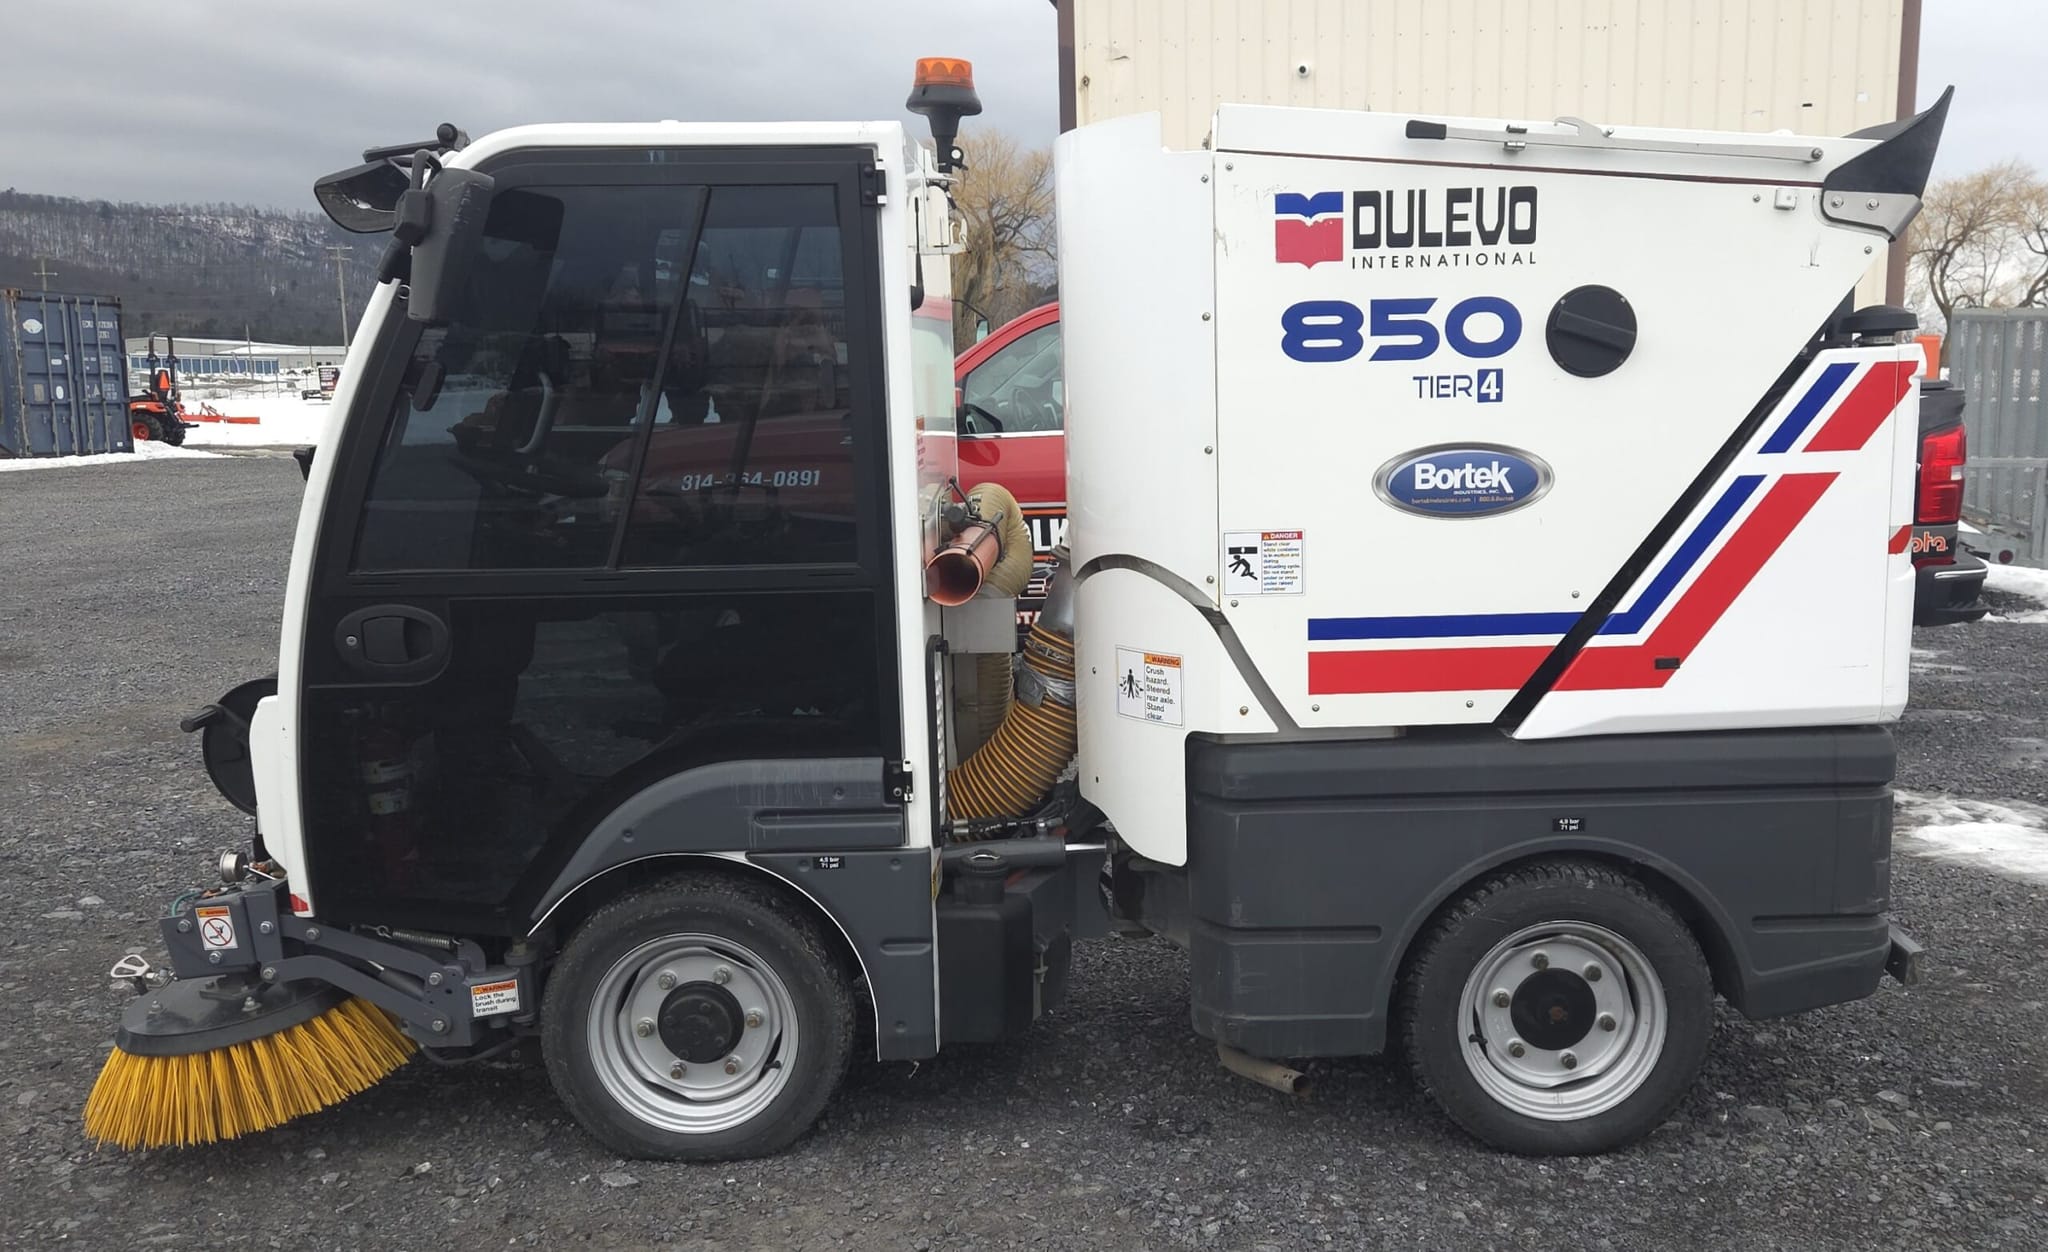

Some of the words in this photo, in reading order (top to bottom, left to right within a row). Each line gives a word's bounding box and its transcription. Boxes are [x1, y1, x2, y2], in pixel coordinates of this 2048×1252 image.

[1352, 185, 1538, 249] DULEVO
[1352, 251, 1537, 269] INTERNATIONAL
[1281, 296, 1523, 363] 850
[1412, 375, 1473, 399] TIER
[1479, 371, 1501, 400] 4
[1414, 461, 1514, 494] Bortek
[1151, 656, 1179, 666] WARNING
[1146, 666, 1165, 675] Crush
[1146, 676, 1168, 685] hazard.
[1146, 684, 1170, 695] Steered
[1147, 694, 1159, 702] rear
[1160, 695, 1175, 704] axle.
[1147, 702, 1164, 712] Stand
[1147, 711, 1163, 720] clear.
[474, 993, 491, 1001] Lock
[495, 996, 517, 1004] during
[476, 1005, 498, 1014] transit
